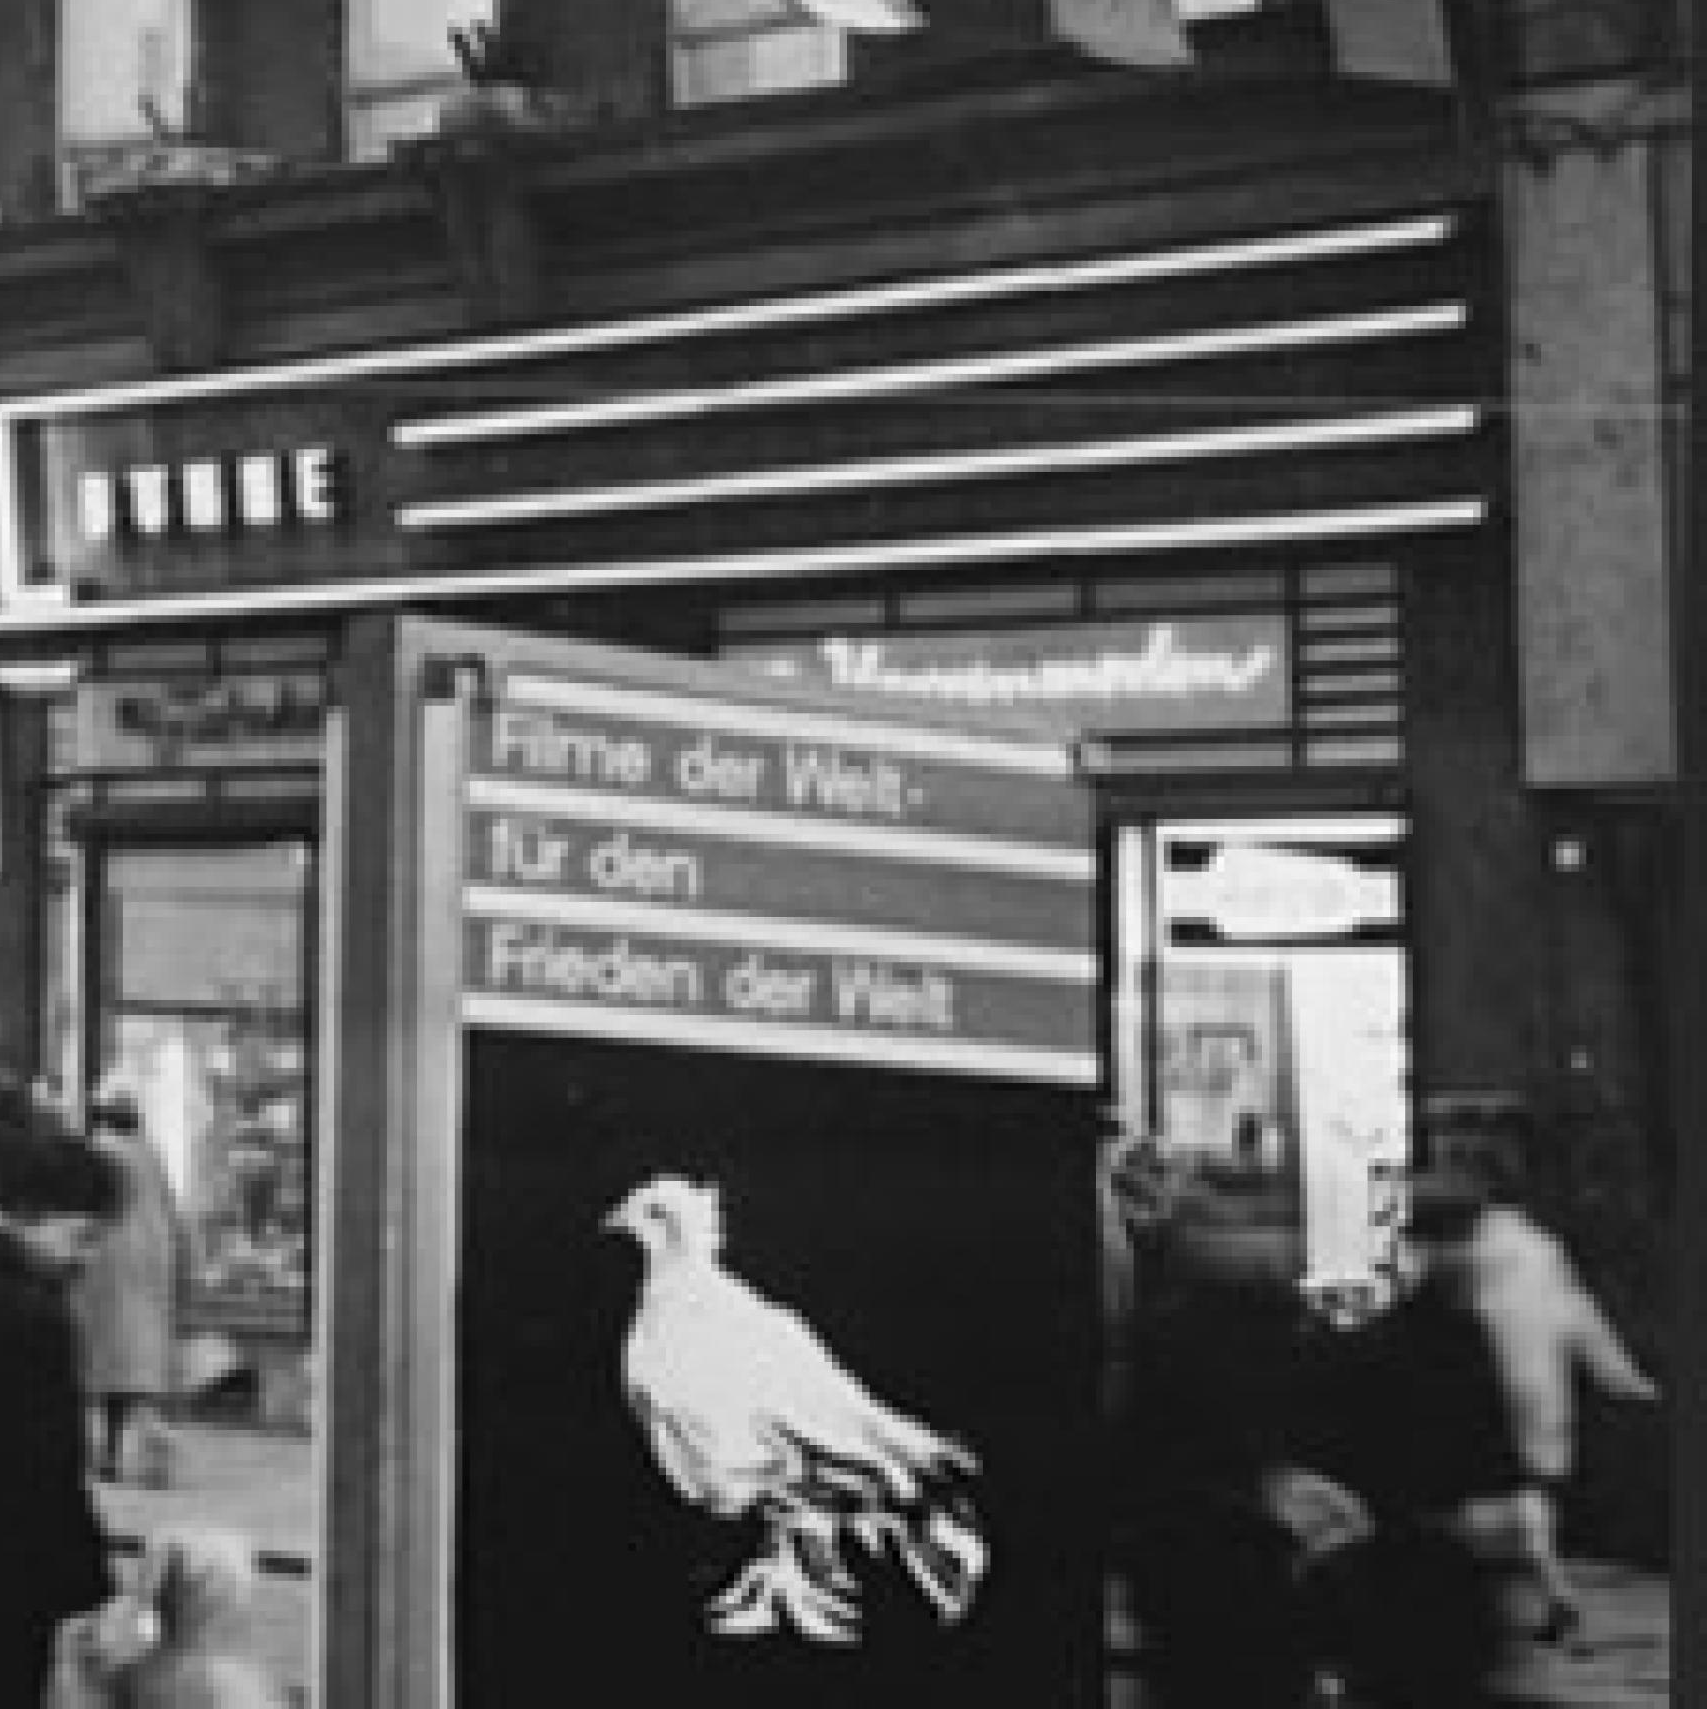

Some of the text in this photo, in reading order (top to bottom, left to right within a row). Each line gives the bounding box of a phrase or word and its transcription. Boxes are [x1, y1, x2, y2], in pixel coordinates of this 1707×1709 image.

[493, 710, 653, 787] Filme
[678, 733, 764, 803] der
[589, 832, 703, 898] den
[489, 922, 955, 1028] Frieden der Welt
